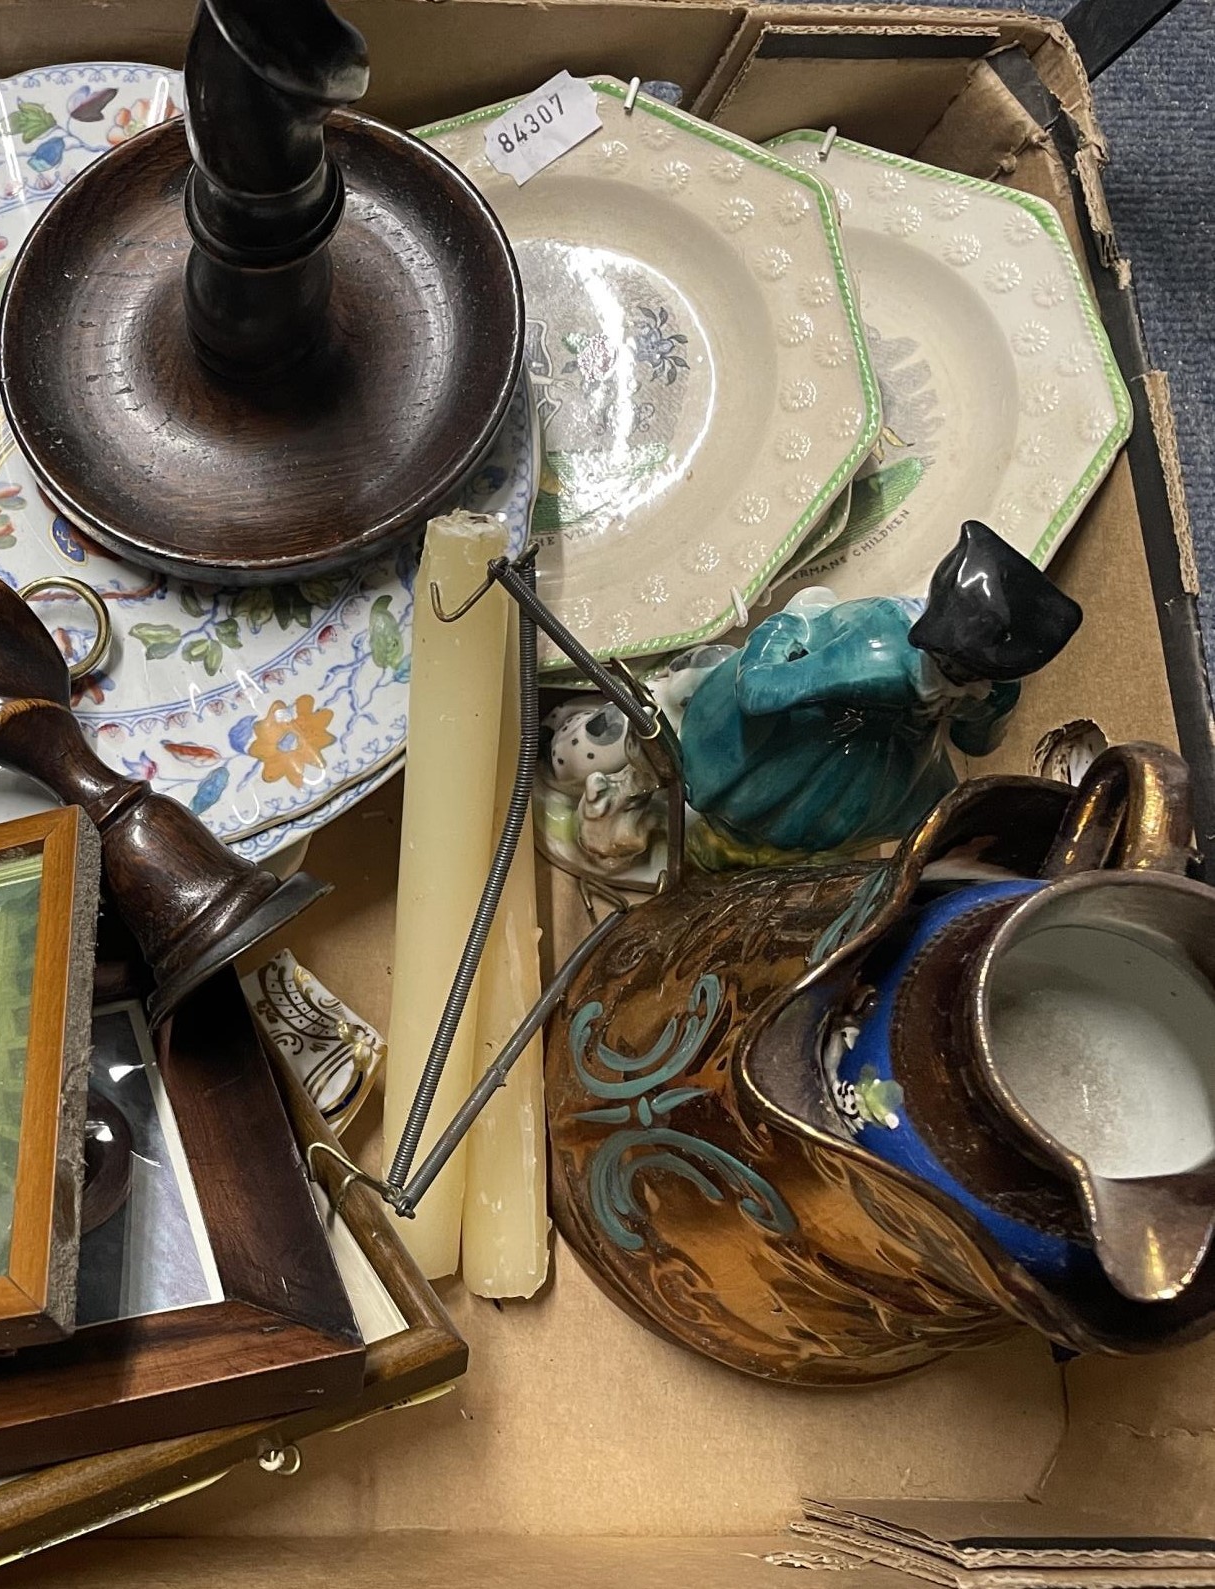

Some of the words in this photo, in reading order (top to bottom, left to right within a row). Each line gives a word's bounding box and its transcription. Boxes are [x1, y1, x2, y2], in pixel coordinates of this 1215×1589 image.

[498, 93, 564, 153] 84307
[788, 556, 848, 580] ERMANS
[853, 510, 910, 557] CHILDREN
